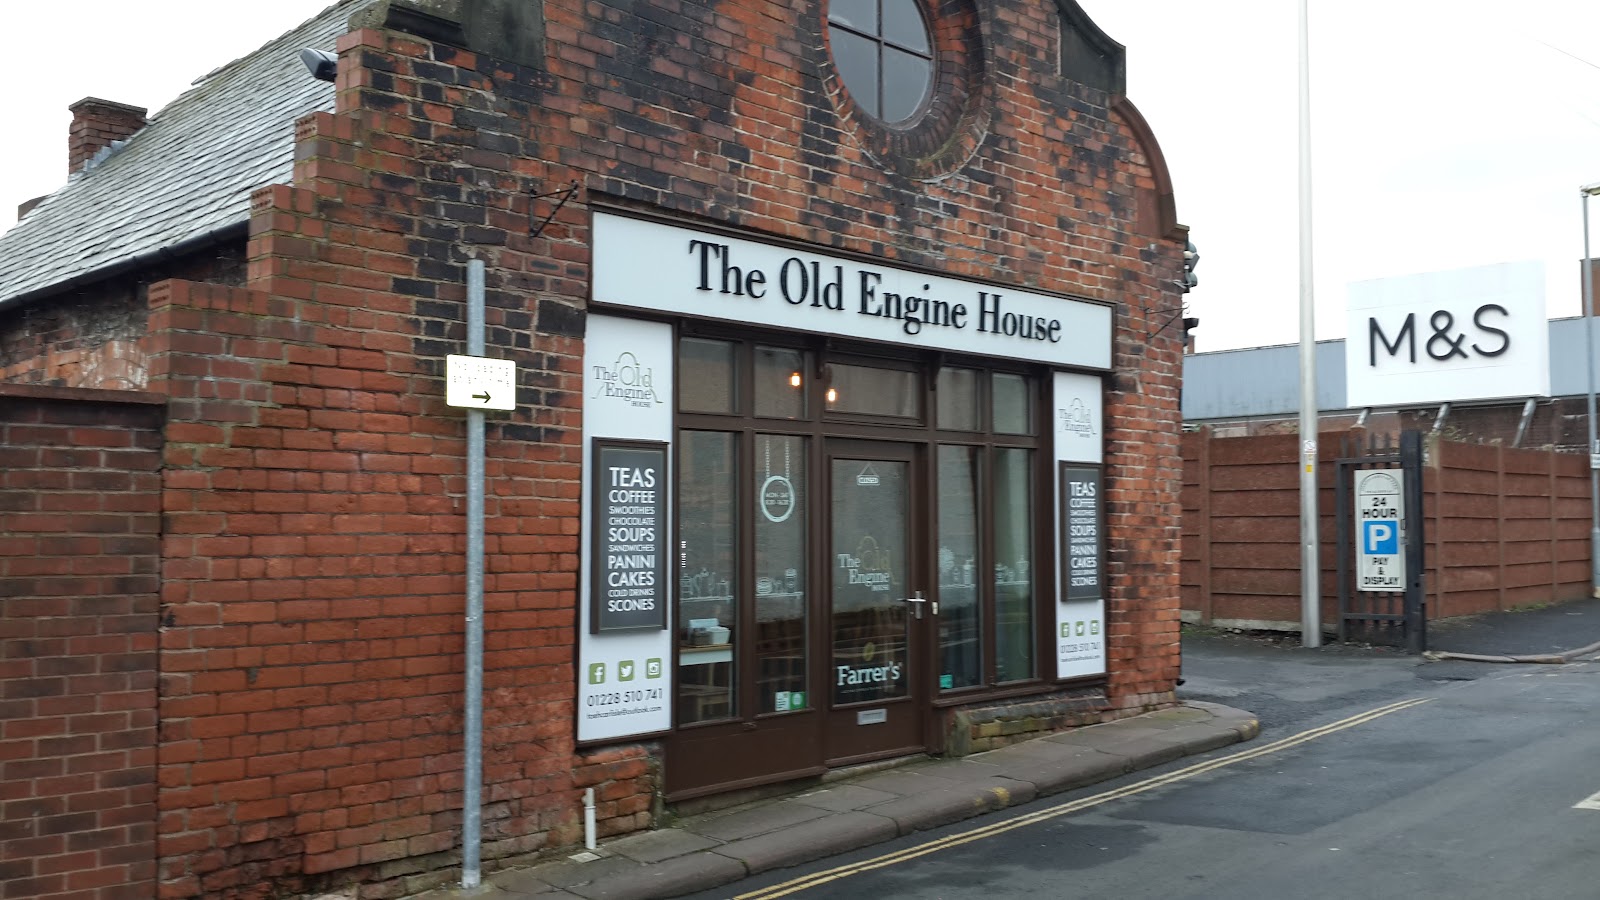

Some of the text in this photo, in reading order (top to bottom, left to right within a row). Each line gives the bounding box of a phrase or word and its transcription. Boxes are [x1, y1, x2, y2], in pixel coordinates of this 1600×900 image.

[689, 239, 1062, 343] The Old Engine House
[1369, 303, 1510, 367] M&S
[593, 366, 652, 387] The Old
[604, 382, 652, 401] Engine
[608, 467, 655, 488] TEAS
[608, 490, 655, 504] COFFEE
[1069, 481, 1096, 497] TEAS
[1372, 497, 1387, 507] 24
[1362, 508, 1398, 519] HOUR
[608, 528, 655, 542] SOUPS
[1369, 524, 1392, 551] P
[608, 555, 655, 569] PANINI
[608, 572, 655, 587] CAKES
[1364, 577, 1399, 585] DISPLAY
[608, 599, 655, 612] SCONES
[837, 661, 900, 686] Farrer's
[587, 688, 663, 707] 01228 510 741
